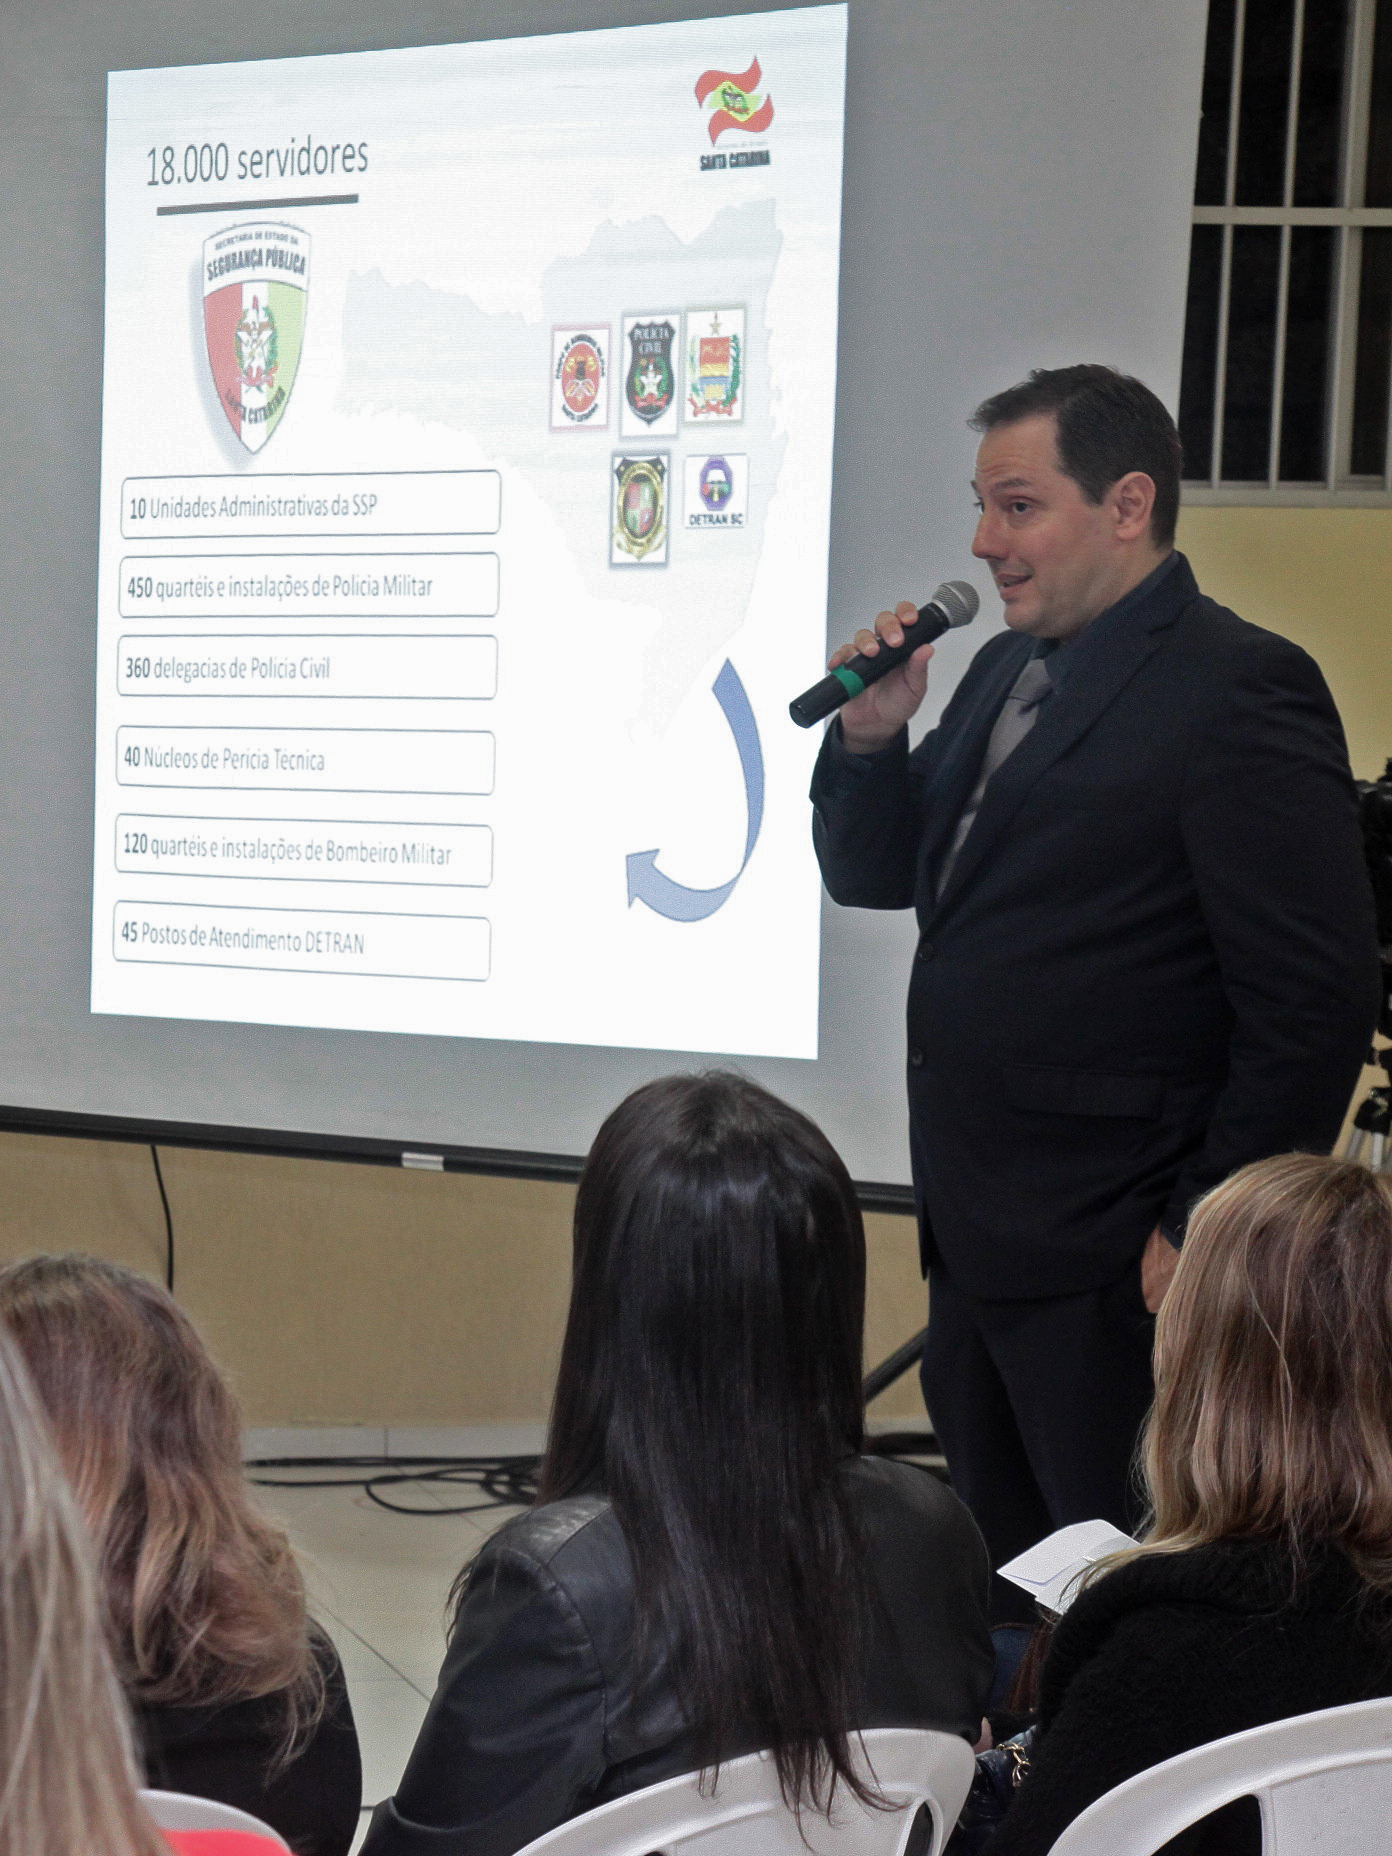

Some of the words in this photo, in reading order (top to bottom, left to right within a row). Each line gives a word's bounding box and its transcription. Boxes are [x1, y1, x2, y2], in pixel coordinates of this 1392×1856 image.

[147, 143, 229, 186] 18.000
[238, 134, 368, 179] servidores
[207, 248, 263, 281] SEGURANÇA
[265, 245, 306, 275] PÚBLICA
[130, 498, 146, 519] 10
[151, 496, 216, 519] Unidades
[218, 495, 328, 517] Administrativas
[331, 494, 349, 516] da
[353, 494, 377, 516] SSP
[128, 577, 153, 598] 450
[156, 576, 214, 602] quartéis
[217, 581, 225, 597] e
[229, 574, 309, 602] instalações
[312, 574, 330, 597] de
[383, 574, 433, 596] Militar
[126, 657, 150, 678] 360
[154, 656, 226, 683] delegacias
[229, 657, 247, 679] de
[300, 657, 330, 679] Civil
[124, 746, 140, 767] 40
[145, 747, 198, 768] Núcleos
[201, 747, 219, 769] de
[125, 833, 147, 854] 120
[151, 836, 207, 859] quartéis
[210, 841, 218, 857] e
[222, 836, 302, 864] instalações
[305, 840, 323, 861] de
[326, 840, 398, 863] Bombeiro
[402, 843, 451, 865] Militar
[122, 922, 137, 942] 45
[142, 922, 186, 945] Postos
[189, 925, 206, 946] de
[209, 926, 301, 952] Atendimento
[306, 931, 364, 954] DETRAN
